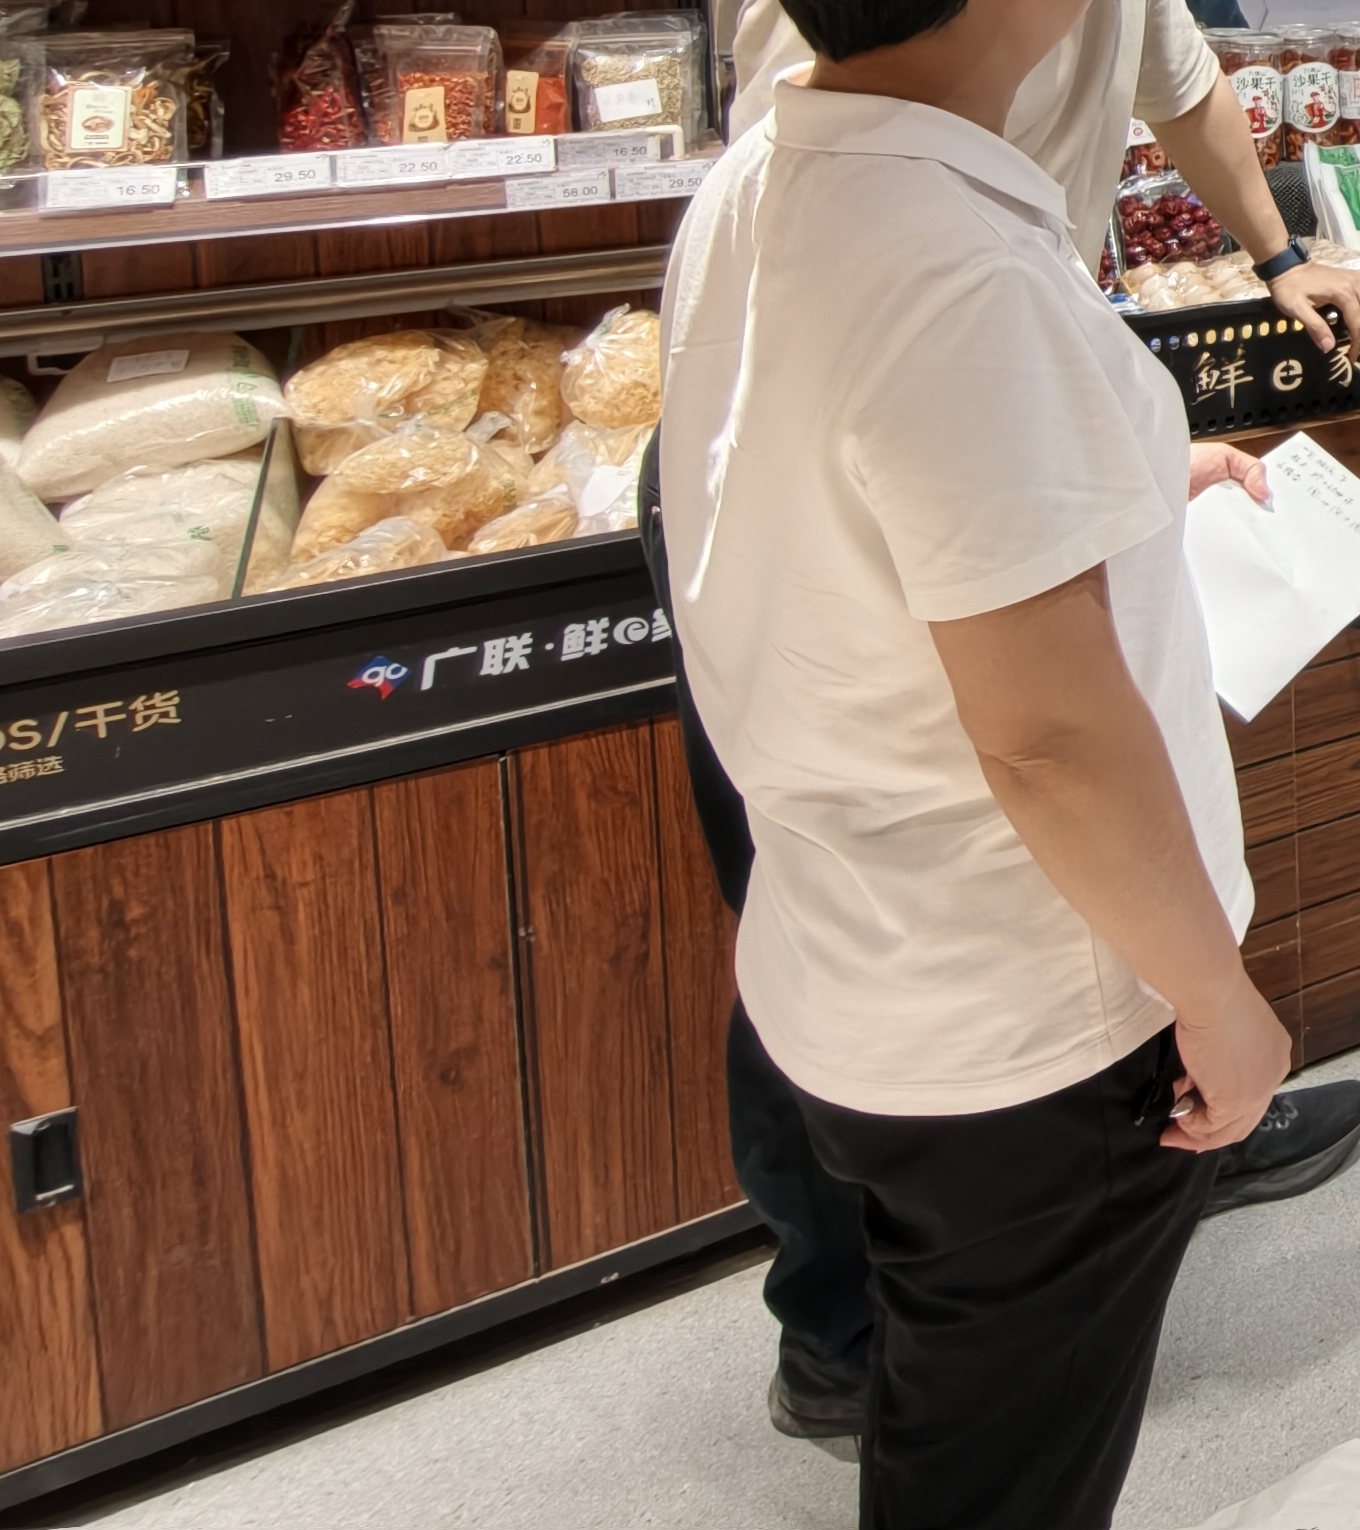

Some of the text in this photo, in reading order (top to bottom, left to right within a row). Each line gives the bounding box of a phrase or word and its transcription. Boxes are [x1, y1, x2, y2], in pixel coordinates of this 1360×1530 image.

[1236, 75, 1277, 91] 沙果干
[1293, 70, 1332, 88] 沙果干
[613, 146, 648, 157] 16.50
[505, 153, 543, 165] 22.50
[274, 170, 316, 183] 29.50
[669, 177, 702, 189] 29.50
[116, 184, 160, 196] 16.50
[563, 185, 598, 198] 58.00
[0, 690, 182, 750] S/干货
